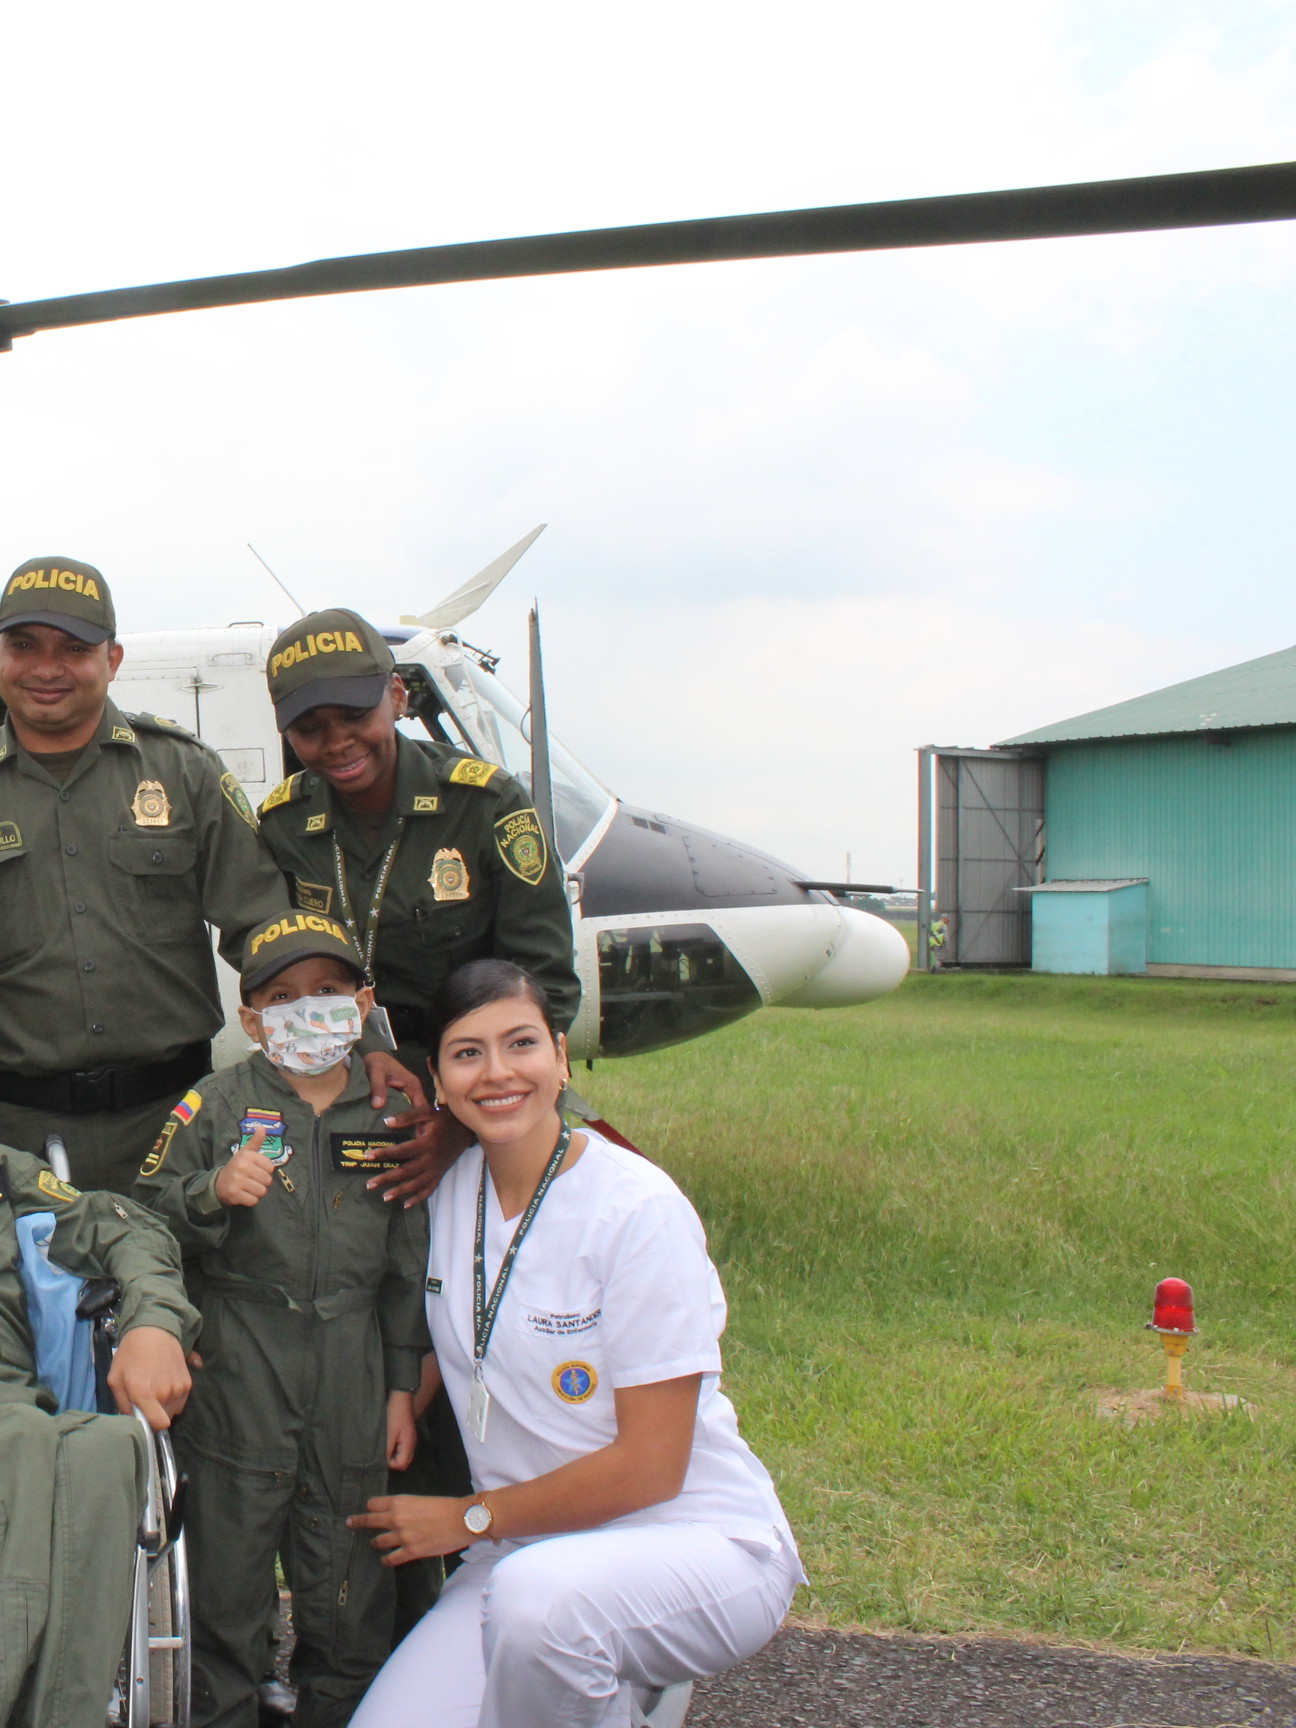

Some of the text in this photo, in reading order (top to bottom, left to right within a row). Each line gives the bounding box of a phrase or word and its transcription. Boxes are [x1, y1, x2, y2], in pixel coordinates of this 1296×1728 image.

[7, 568, 99, 600] POLICIA
[271, 631, 363, 677] POLICIA
[500, 824, 540, 848] NACIONAL
[251, 914, 349, 955] POLICIA
[537, 1149, 564, 1197] NACIONAL
[518, 1198, 540, 1236] POLICIA
[488, 1266, 508, 1319] NACIONAL
[527, 1308, 602, 1328] LAURA SANTANDER
